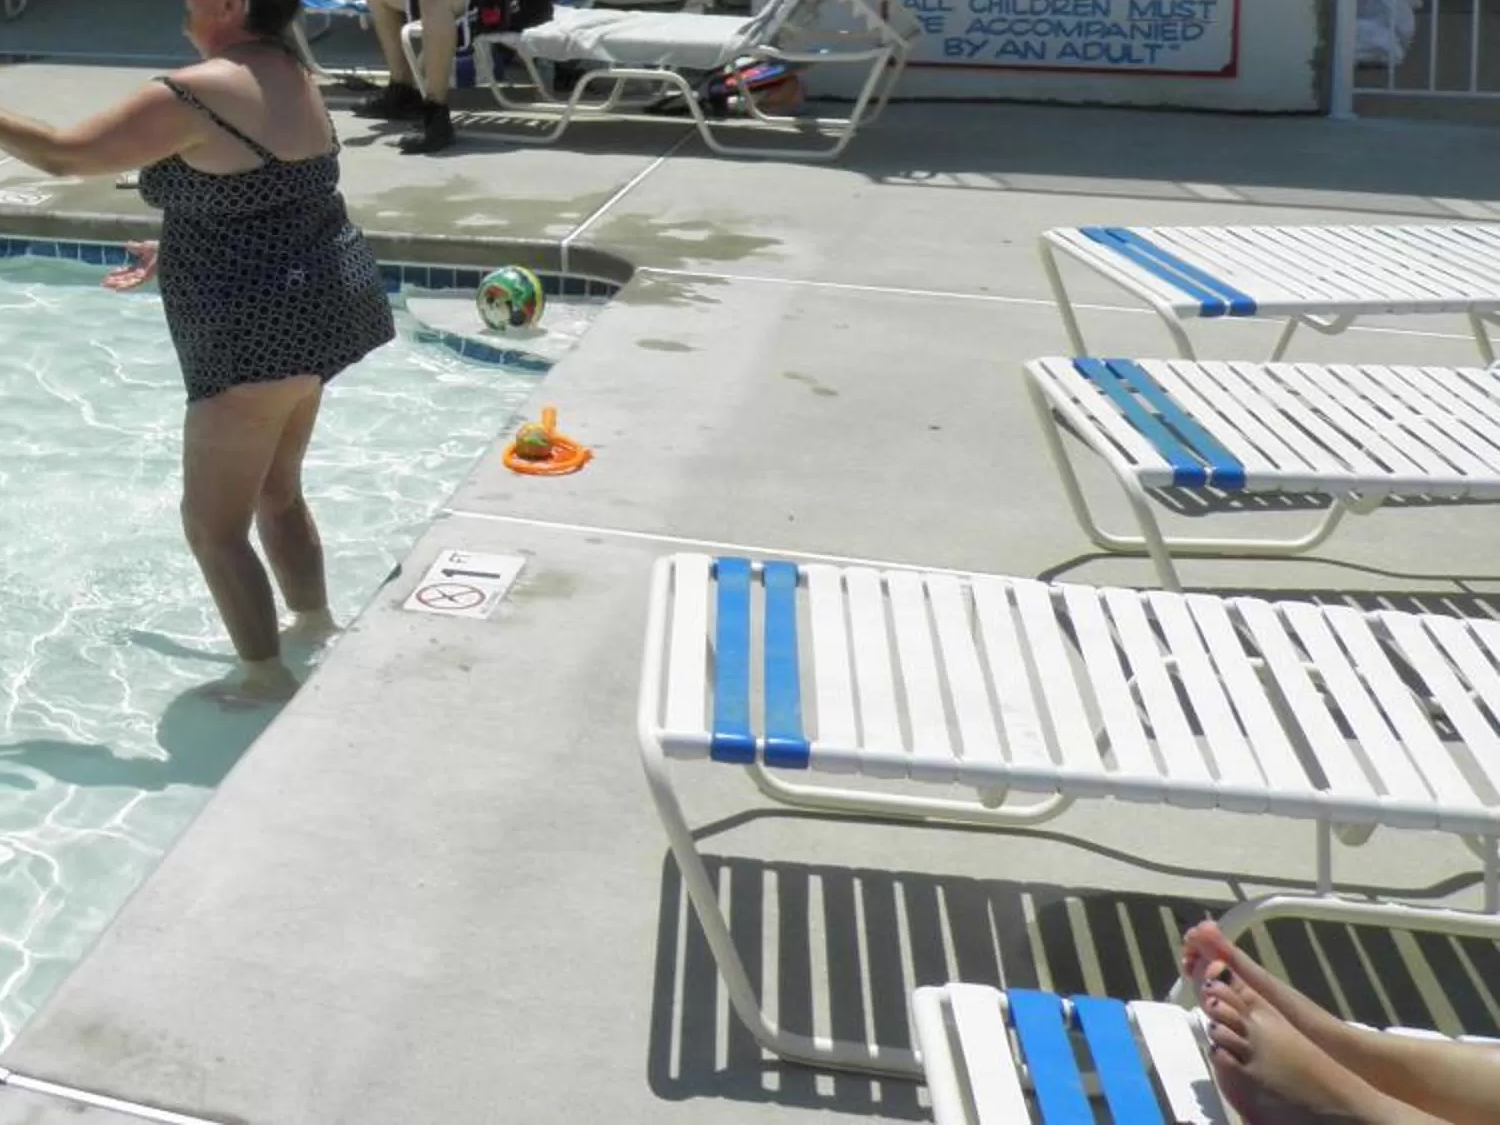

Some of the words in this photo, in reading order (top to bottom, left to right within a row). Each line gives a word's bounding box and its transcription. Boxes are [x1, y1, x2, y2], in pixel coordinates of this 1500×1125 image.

[916, 15, 946, 34] E
[965, 18, 1204, 42] ACCOMPANIED
[944, 36, 989, 58] BY
[995, 38, 1047, 61] AN
